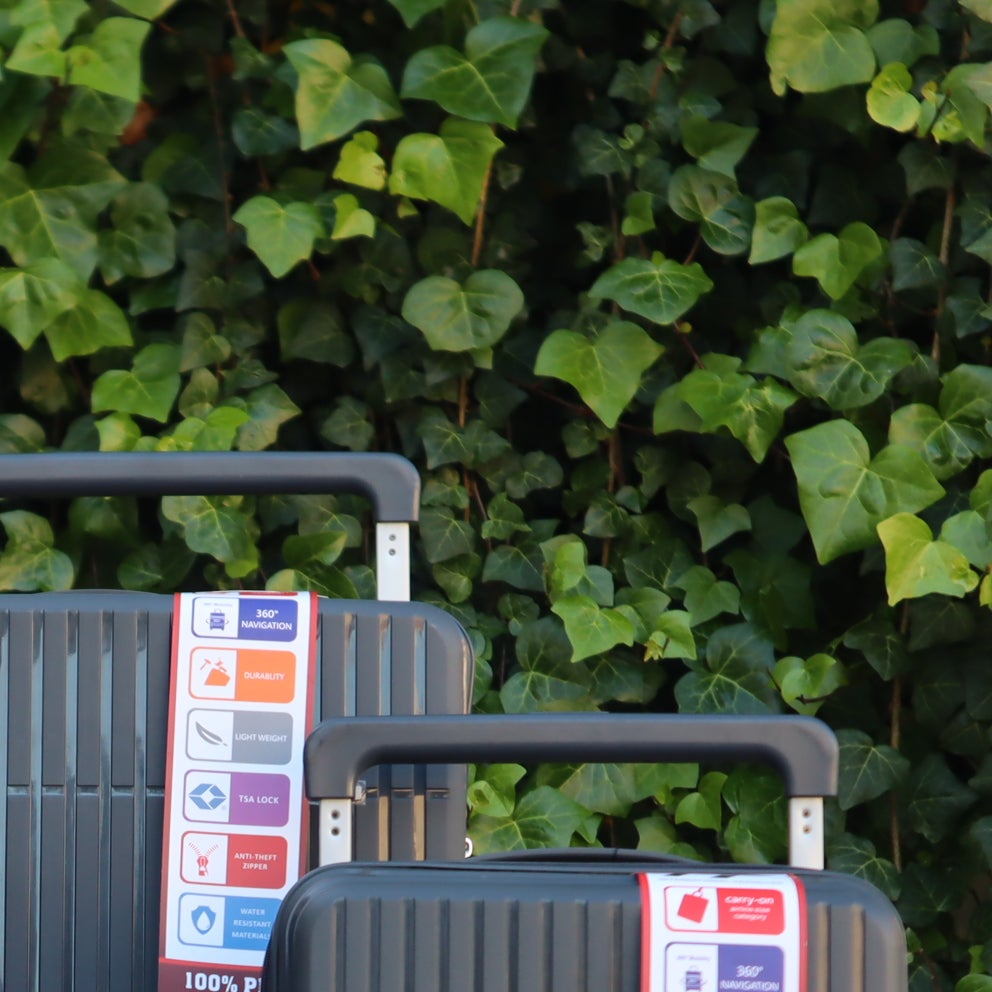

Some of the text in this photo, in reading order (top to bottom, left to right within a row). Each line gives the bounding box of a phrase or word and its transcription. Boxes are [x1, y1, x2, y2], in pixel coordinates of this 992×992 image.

[256, 609, 279, 618] 360°
[241, 620, 292, 631] NAVIGATION
[244, 672, 285, 681] DURABLITY
[235, 733, 287, 743] LIGHT WEIGHT
[239, 795, 279, 804] TSA LOCK
[234, 853, 277, 861] ANTI-THEFT
[243, 862, 268, 870] ZIPPER
[241, 908, 265, 916] WATER
[185, 972, 238, 992] 100%
[720, 980, 780, 992] NAVIGATION
